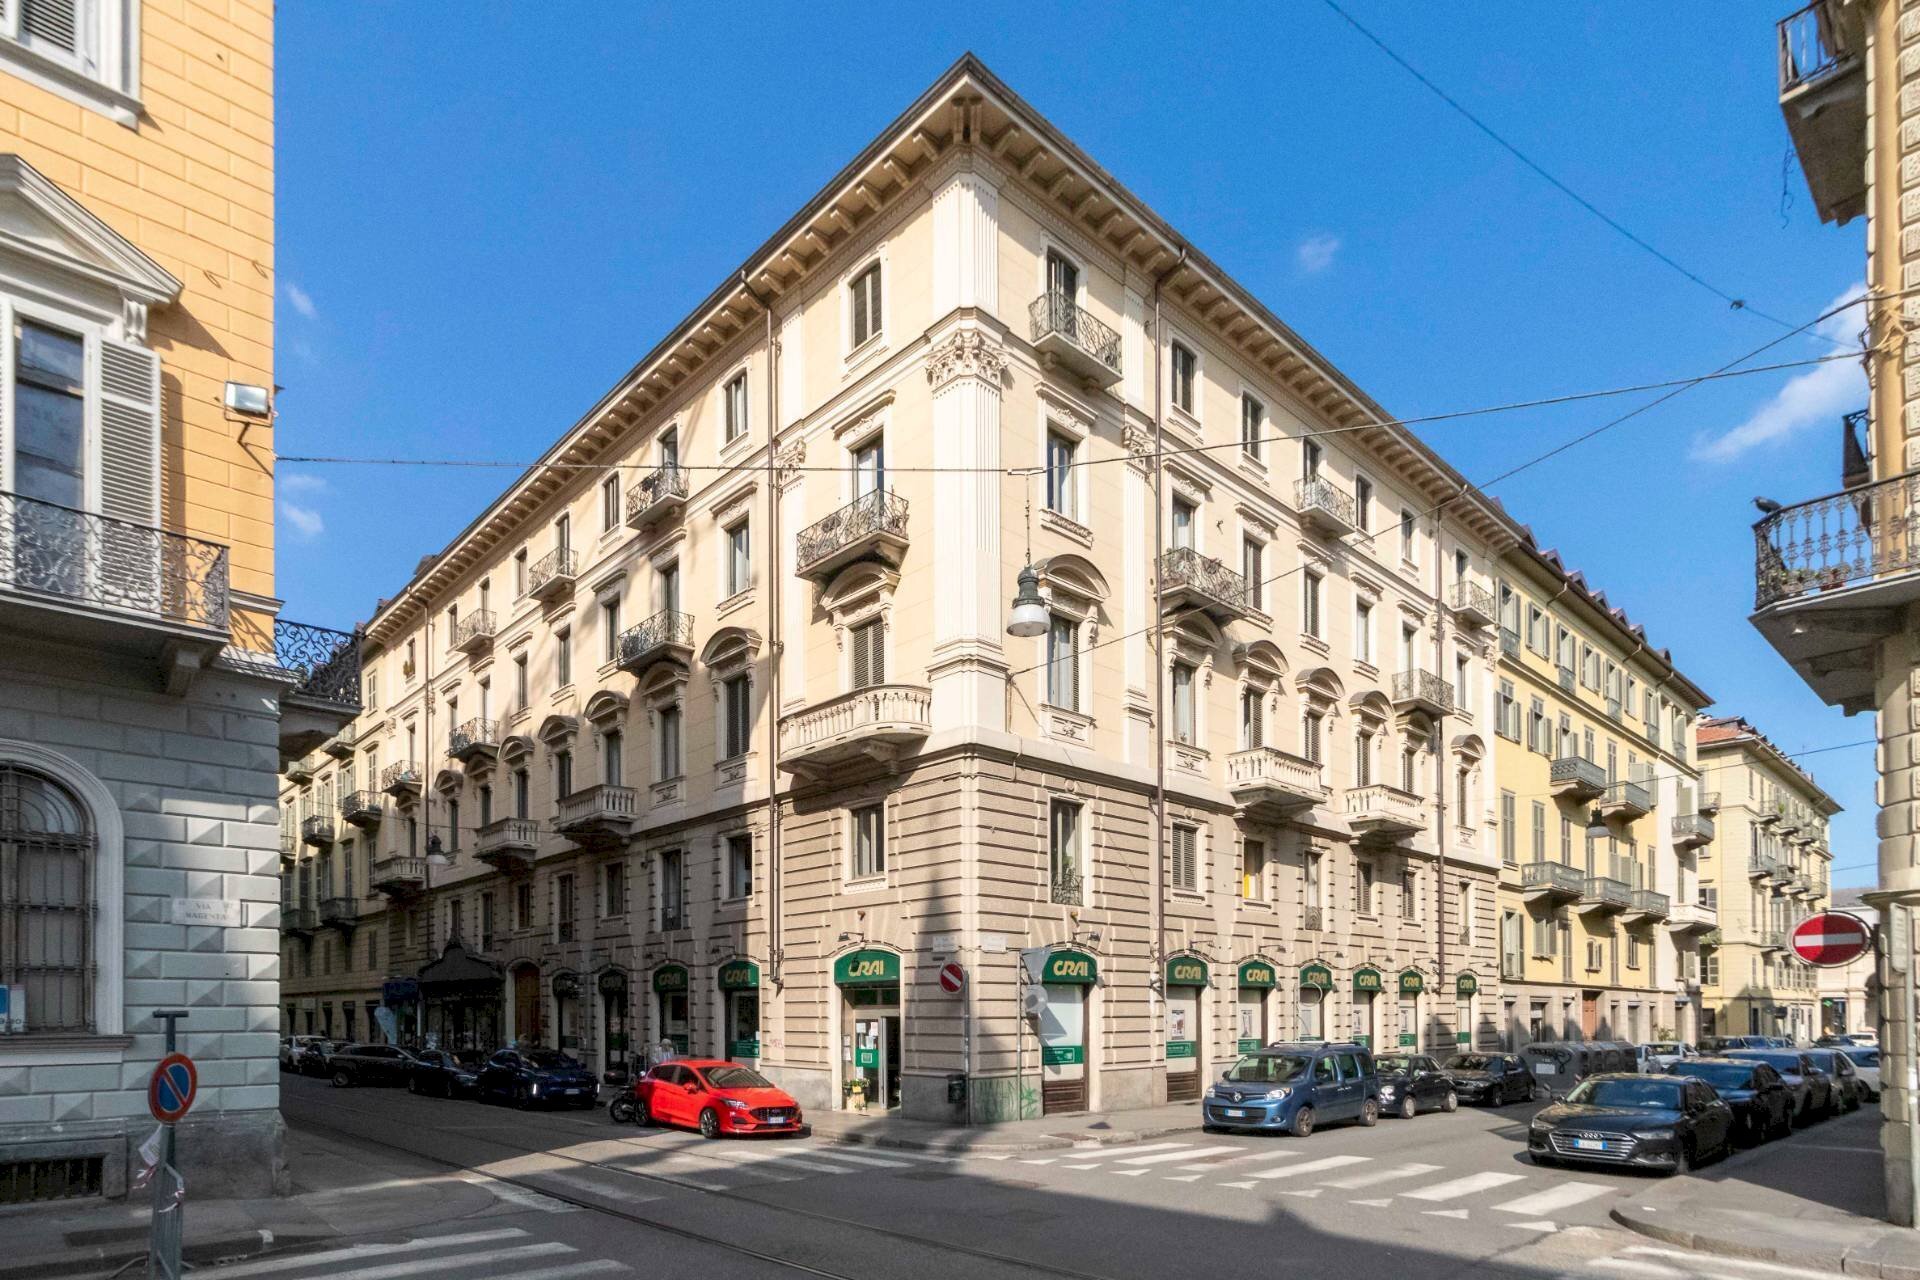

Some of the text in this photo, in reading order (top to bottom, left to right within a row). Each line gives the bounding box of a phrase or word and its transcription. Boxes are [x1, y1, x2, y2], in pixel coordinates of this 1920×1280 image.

[1053, 960, 1088, 976] CRAI
[1175, 965, 1201, 979] CRAI
[725, 968, 751, 983] CRAI
[1246, 969, 1270, 982] CRAI
[1307, 972, 1328, 984] CRAI
[1359, 975, 1377, 986] CRAI
